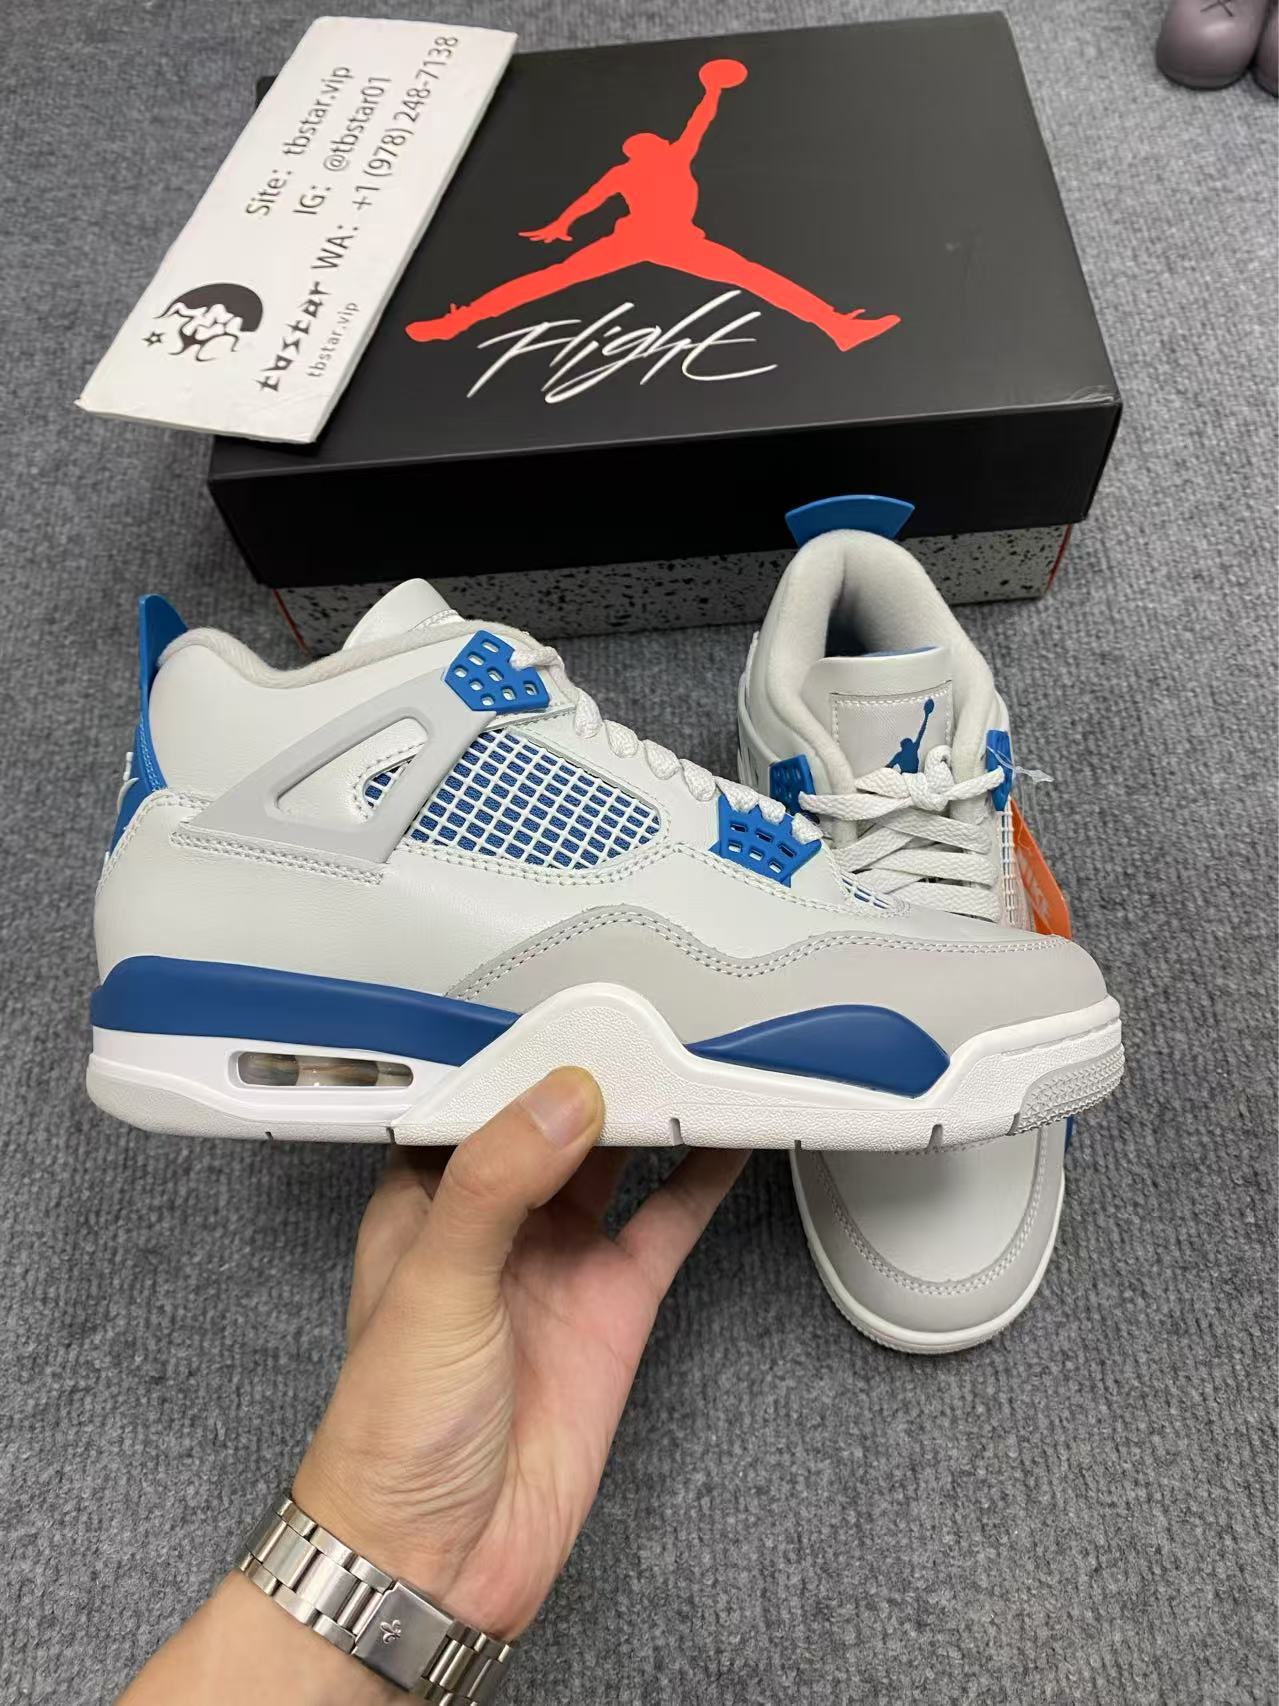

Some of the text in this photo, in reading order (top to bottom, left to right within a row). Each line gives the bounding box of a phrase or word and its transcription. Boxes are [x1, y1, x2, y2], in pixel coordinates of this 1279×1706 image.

[246, 66, 353, 216] Site: tbstar.vip
[293, 76, 391, 215] IG: @tbstar01
[311, 36, 458, 270] WA: +1 (978) 248-7138
[306, 302, 360, 377] tbstar.vip
[467, 290, 778, 403] Flight
